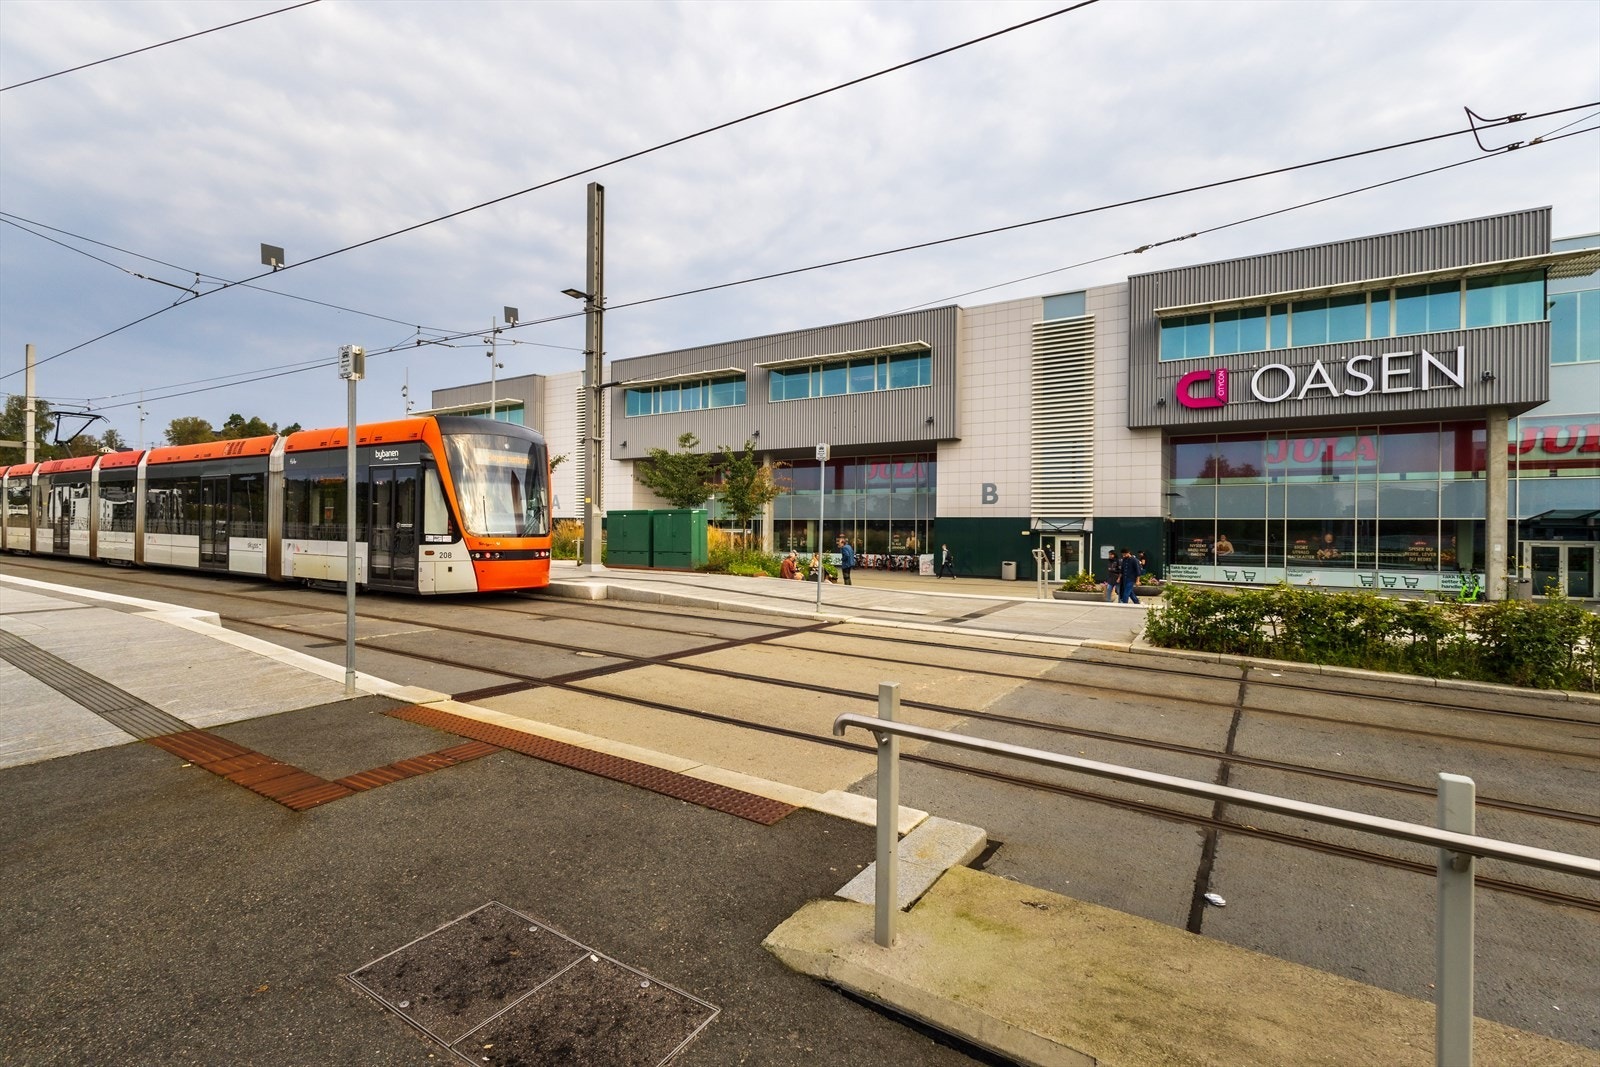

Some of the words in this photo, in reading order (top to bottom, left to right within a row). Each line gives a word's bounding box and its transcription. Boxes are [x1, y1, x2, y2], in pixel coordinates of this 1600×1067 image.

[1217, 370, 1225, 397] CITYCON
[1251, 345, 1465, 403] OASEN
[375, 449, 399, 461] bybanen
[1265, 436, 1378, 464] JULA
[552, 494, 561, 510] A
[982, 482, 999, 505] B
[439, 551, 452, 560] 208
